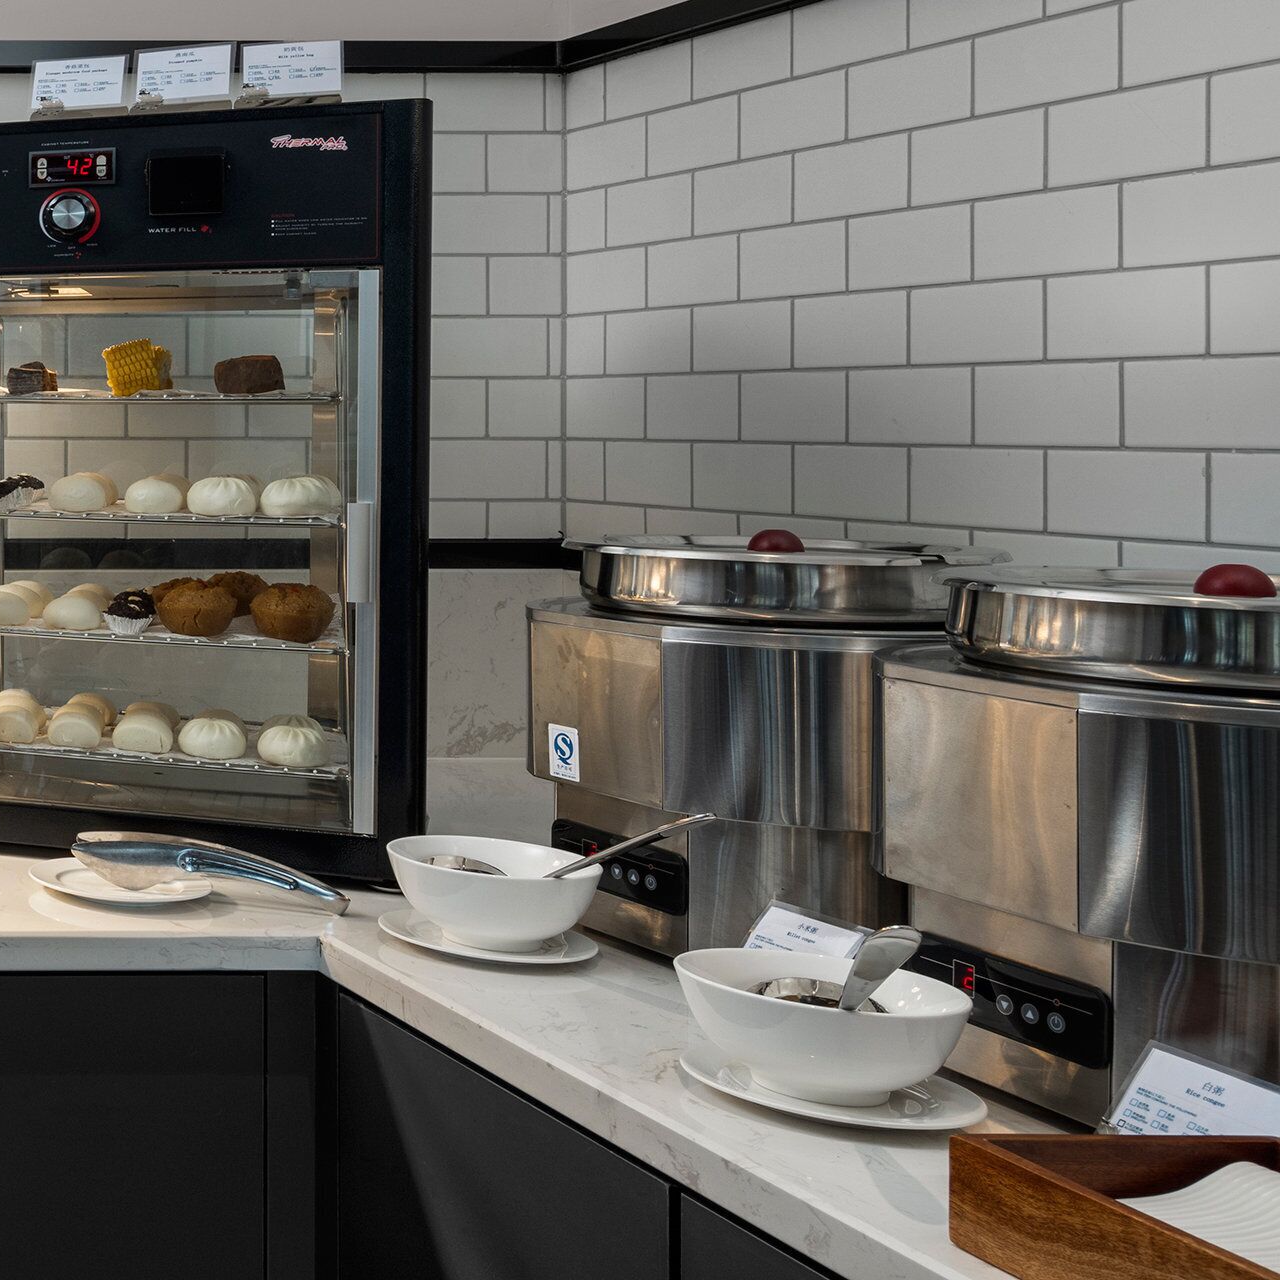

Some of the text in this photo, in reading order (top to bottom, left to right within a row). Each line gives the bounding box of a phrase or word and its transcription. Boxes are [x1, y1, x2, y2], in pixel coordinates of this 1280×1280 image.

[270, 133, 346, 149] THERMAL
[66, 158, 93, 175] 42
[1202, 1081, 1226, 1097] 白粥
[1185, 1087, 1226, 1108] Rice congee
